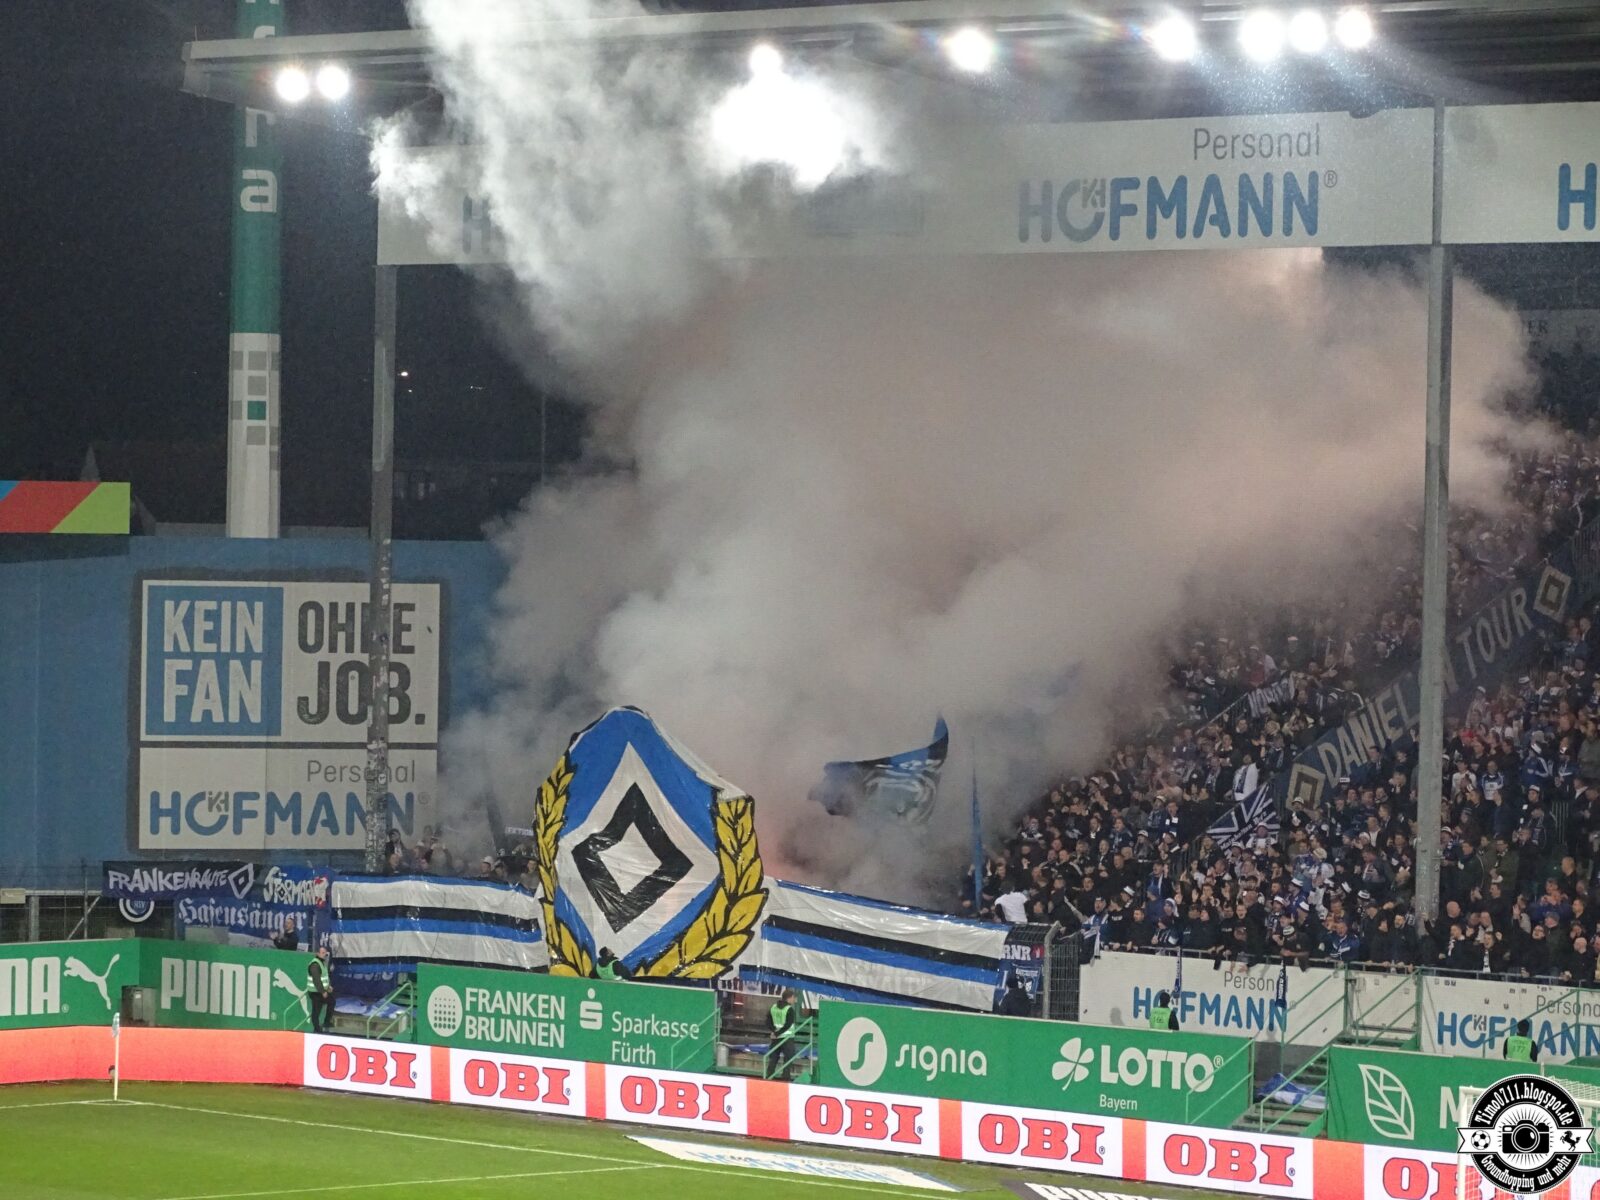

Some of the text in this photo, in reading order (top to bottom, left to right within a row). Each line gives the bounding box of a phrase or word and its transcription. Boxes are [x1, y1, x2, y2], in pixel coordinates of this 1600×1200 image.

[1193, 124, 1320, 160] Personal
[1018, 170, 1320, 243] HOFMANN
[163, 600, 263, 653] KEIN
[1456, 587, 1536, 680] TOUR
[163, 659, 262, 723] FAN
[306, 760, 416, 783] Persnal
[108, 866, 228, 894] FRANKENRAUTE
[160, 956, 271, 1020] PUMA
[1224, 971, 1275, 991] Person
[465, 986, 566, 1021] FRANKEN
[465, 1014, 566, 1049] BRUNNEN
[611, 1011, 700, 1040] Sparkasse
[611, 1040, 656, 1065] Fürth
[1099, 1094, 1138, 1112] Bayern
